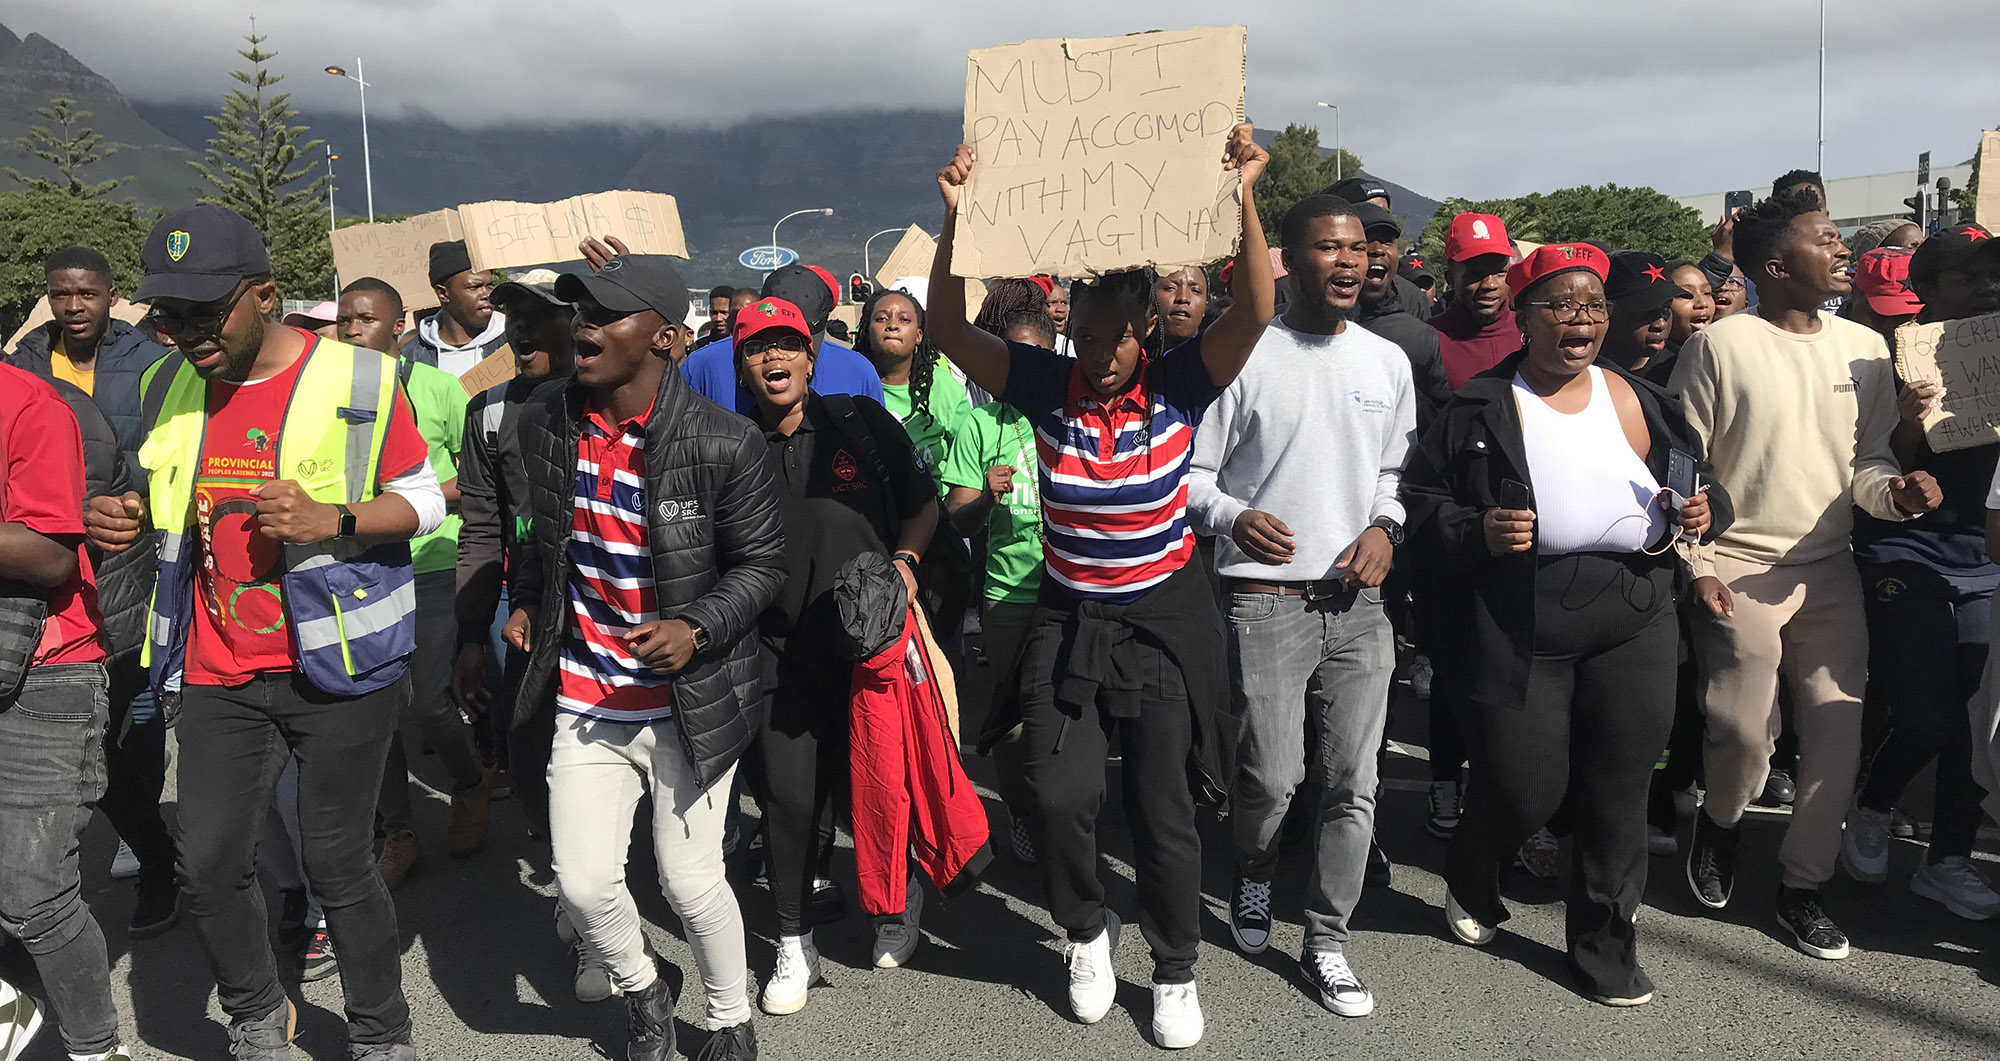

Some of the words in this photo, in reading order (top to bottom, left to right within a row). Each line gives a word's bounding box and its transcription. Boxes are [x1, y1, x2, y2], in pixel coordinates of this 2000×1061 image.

[974, 43, 1138, 114] MUST
[1131, 37, 1201, 96] I
[972, 115, 1049, 166] PAY
[1062, 101, 1234, 160] ACCOMOD
[963, 174, 1072, 227] WITH
[1082, 160, 1167, 212] MY
[750, 250, 783, 266] Ford
[1575, 247, 1593, 261] EFF
[781, 308, 797, 319] EFF
[1833, 383, 1858, 393] PUMA
[208, 457, 274, 470] PROVINCIAL
[231, 469, 261, 477] ASSEMBLY
[681, 500, 699, 509] UFS
[681, 508, 698, 517] SRC
